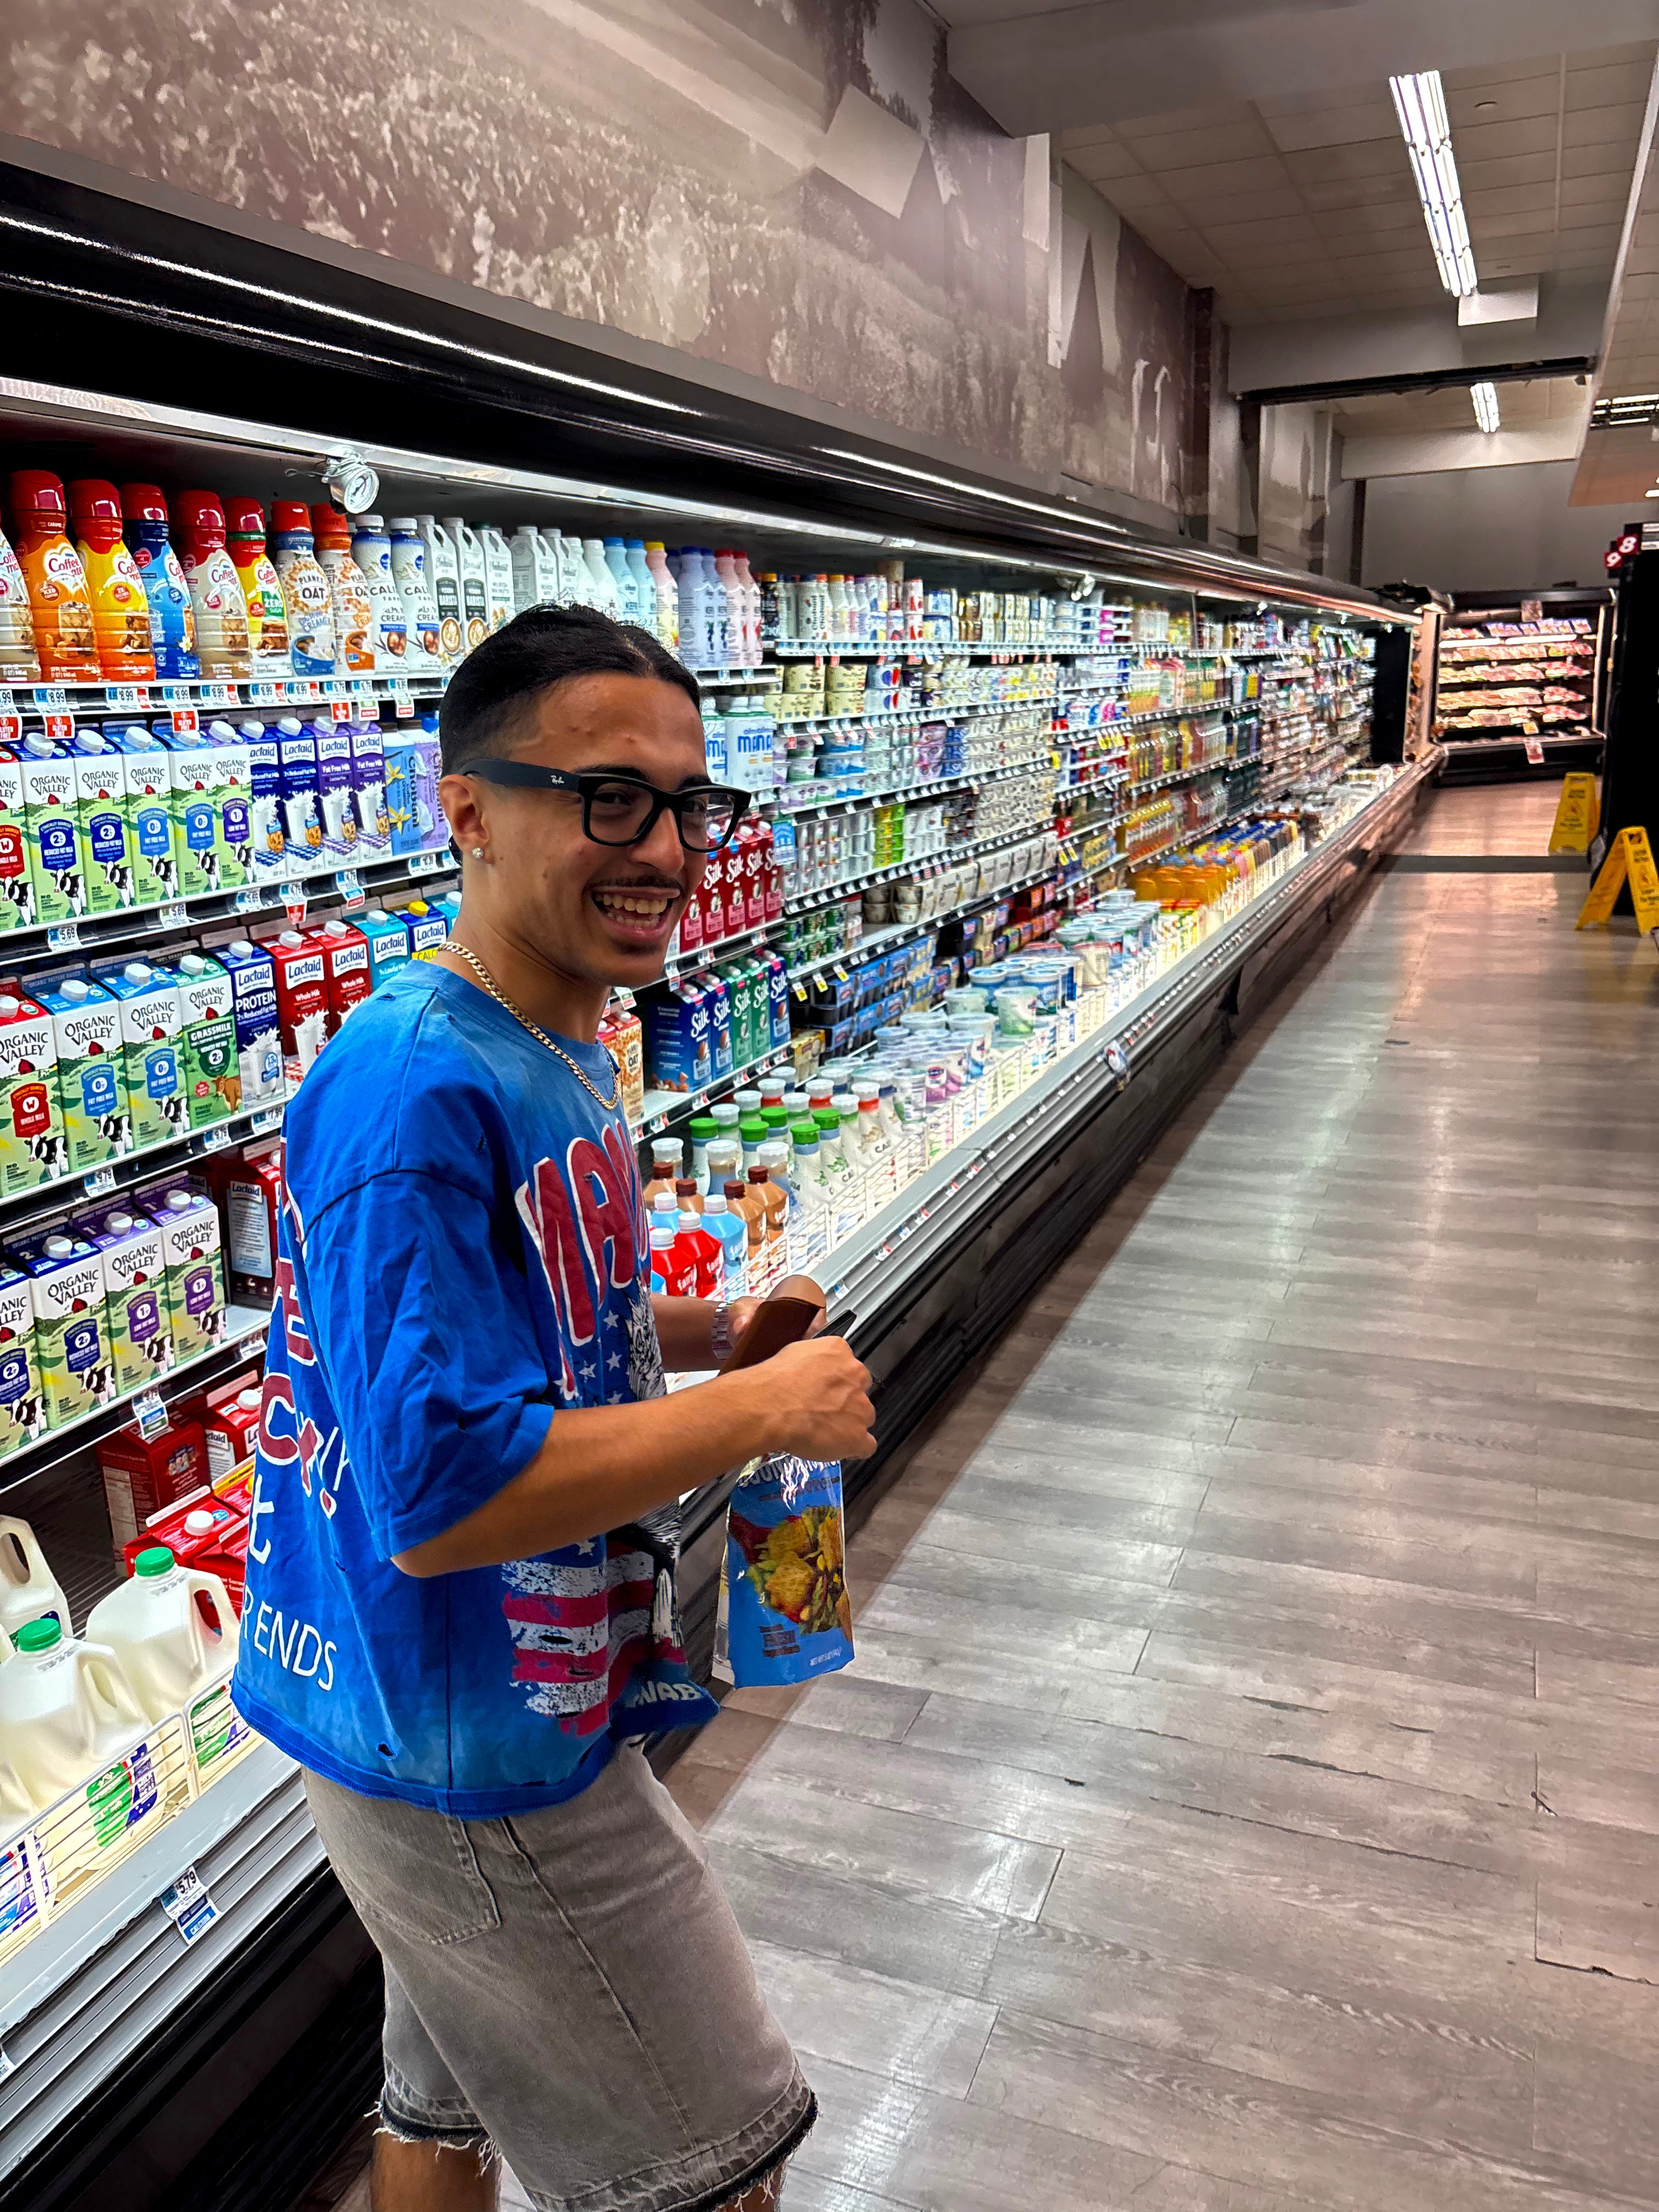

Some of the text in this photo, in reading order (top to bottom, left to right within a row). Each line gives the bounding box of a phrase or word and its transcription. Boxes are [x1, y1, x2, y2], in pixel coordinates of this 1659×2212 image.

[1618, 537, 1637, 554] 8
[48, 557, 80, 572] Coffee
[1606, 551, 1622, 567] 9
[211, 568, 235, 583] Coffee
[298, 575, 324, 584] PLANET
[302, 587, 325, 599] OAT
[264, 599, 283, 608] ZERO
[250, 746, 275, 757] actaid
[285, 742, 313, 755] Lactaid
[321, 740, 347, 752] Lactaid
[356, 737, 380, 749] Lactaid
[180, 763, 213, 775] ORGANIC
[216, 759, 247, 770] ORGANIC
[219, 768, 245, 778] VALLEY
[30, 775, 71, 788] ORGANIC
[82, 770, 120, 783] ORGANIC
[131, 768, 165, 779] ORGANIC
[134, 775, 162, 786] VALLEY
[184, 772, 211, 783] VALLEY
[35, 785, 68, 795] VALLEY
[86, 780, 117, 791] VALLEY
[409, 755, 419, 828] Chobani
[0, 840, 9, 851] W
[725, 854, 745, 883] Silk
[746, 849, 764, 877] Silk
[703, 860, 724, 890] Silk
[417, 924, 444, 942] Lactaid
[376, 934, 405, 954] Lactaid
[335, 949, 365, 968] Lactaid
[238, 967, 270, 987] Lactaid
[289, 961, 321, 979] Lactaid
[770, 972, 788, 999] Silk
[189, 986, 225, 1003] ORGANIC
[194, 996, 224, 1010] VALLEY
[235, 989, 276, 1013] PROTEIN
[295, 988, 320, 1001] Whole Milk
[753, 981, 769, 1009] Silk
[131, 1001, 176, 1022] ORGANIC
[713, 997, 731, 1027] Silk
[734, 989, 752, 1018] Silk
[136, 1013, 173, 1031] VALLEY
[245, 1009, 262, 1019] Reduced
[690, 1007, 710, 1038] Silk
[65, 1015, 116, 1037] ORGANIC
[190, 1022, 232, 1042] GRASSMILK
[71, 1027, 113, 1046] VALLEY
[0, 1045, 45, 1064] VALLEY
[628, 1056, 639, 1066] OAT
[26, 1099, 35, 1110] W
[233, 1182, 261, 1197] Lactaid
[171, 1221, 215, 1246] ORGANIC
[176, 1232, 212, 1254] VALLEY
[112, 1243, 159, 1272] ORGANIC
[117, 1255, 156, 1278] VALLEY
[48, 1268, 99, 1298] ORGANIC
[54, 1281, 97, 1306] VALLEY
[0, 1295, 27, 1313] ANIC
[204, 1433, 225, 1444] ctaid
